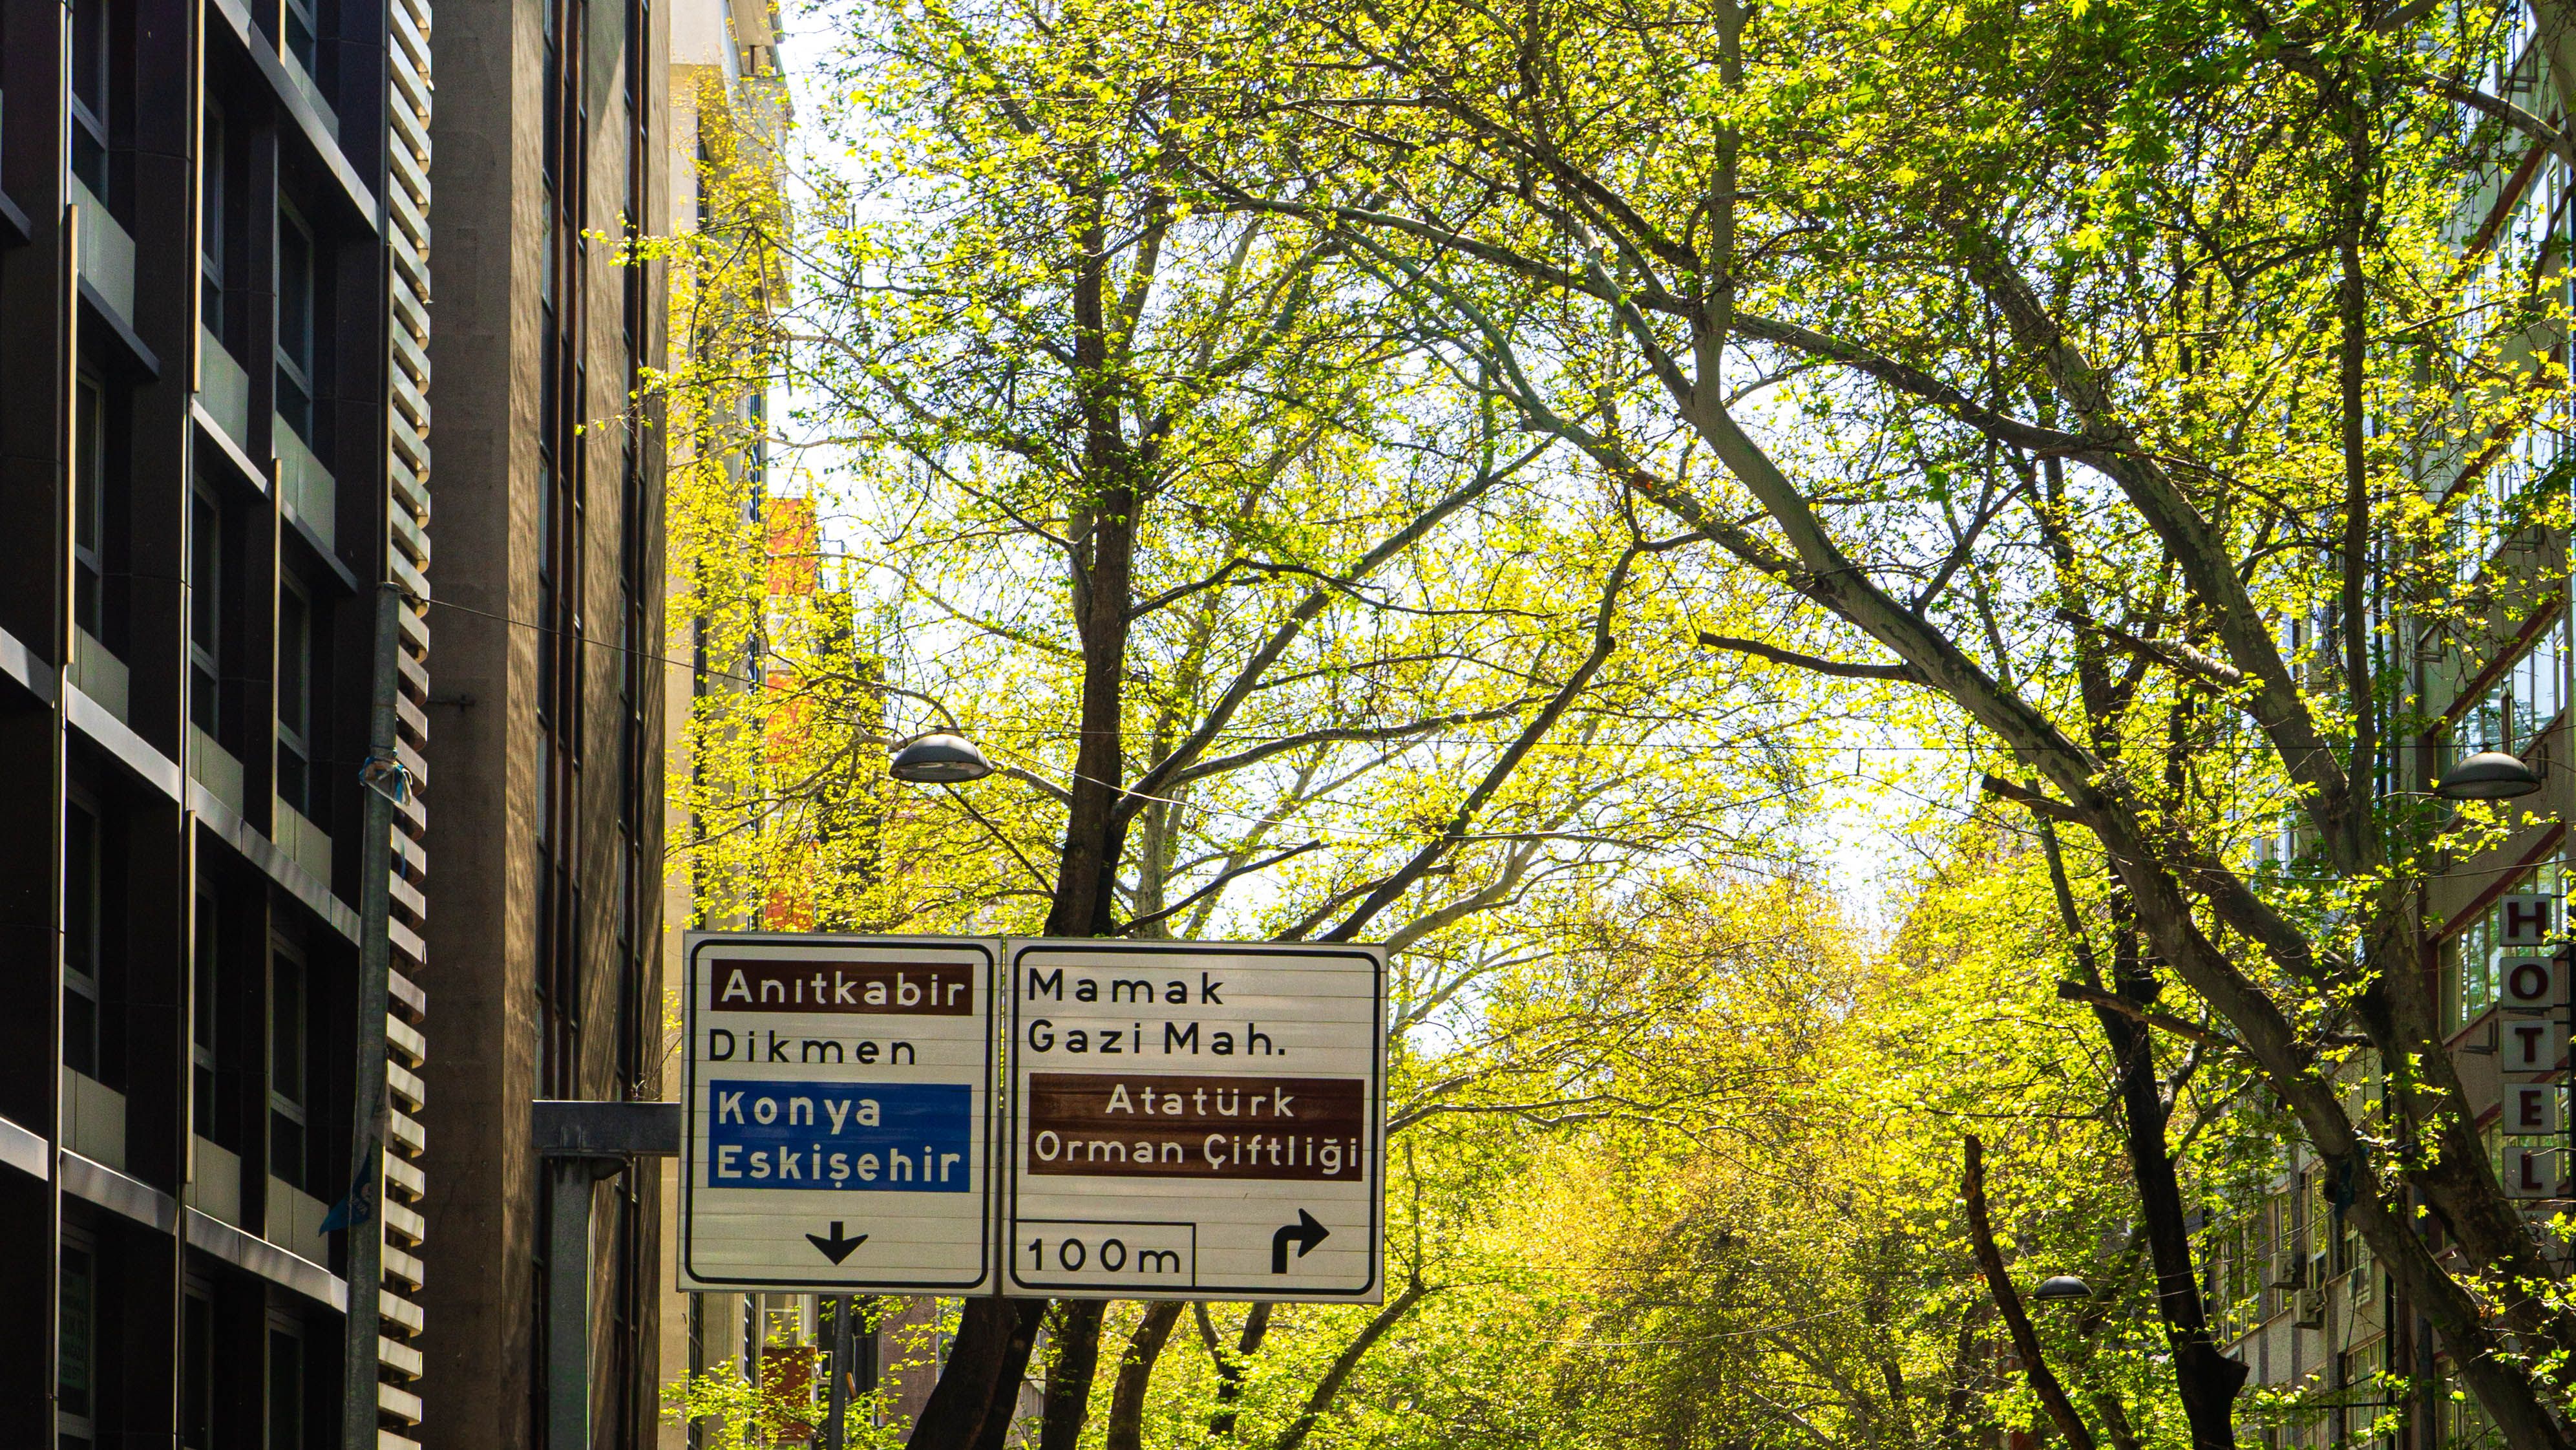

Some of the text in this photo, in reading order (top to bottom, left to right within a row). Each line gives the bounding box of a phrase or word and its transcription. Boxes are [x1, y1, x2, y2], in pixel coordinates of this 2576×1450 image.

[721, 969, 966, 1007] Anıtkabir
[1029, 968, 1222, 1004] Mamak
[709, 1029, 914, 1065] Dikmen
[1029, 1019, 1285, 1055] Gazi Mah.
[2507, 901, 2549, 1191] HOTEL
[719, 1092, 880, 1135] Konya
[1105, 1084, 1293, 1116] Atatürk
[719, 1144, 960, 1188] Eskişehir
[1036, 1131, 1356, 1174] Orman Çiftliği
[1029, 1239, 1179, 1273] 100m
